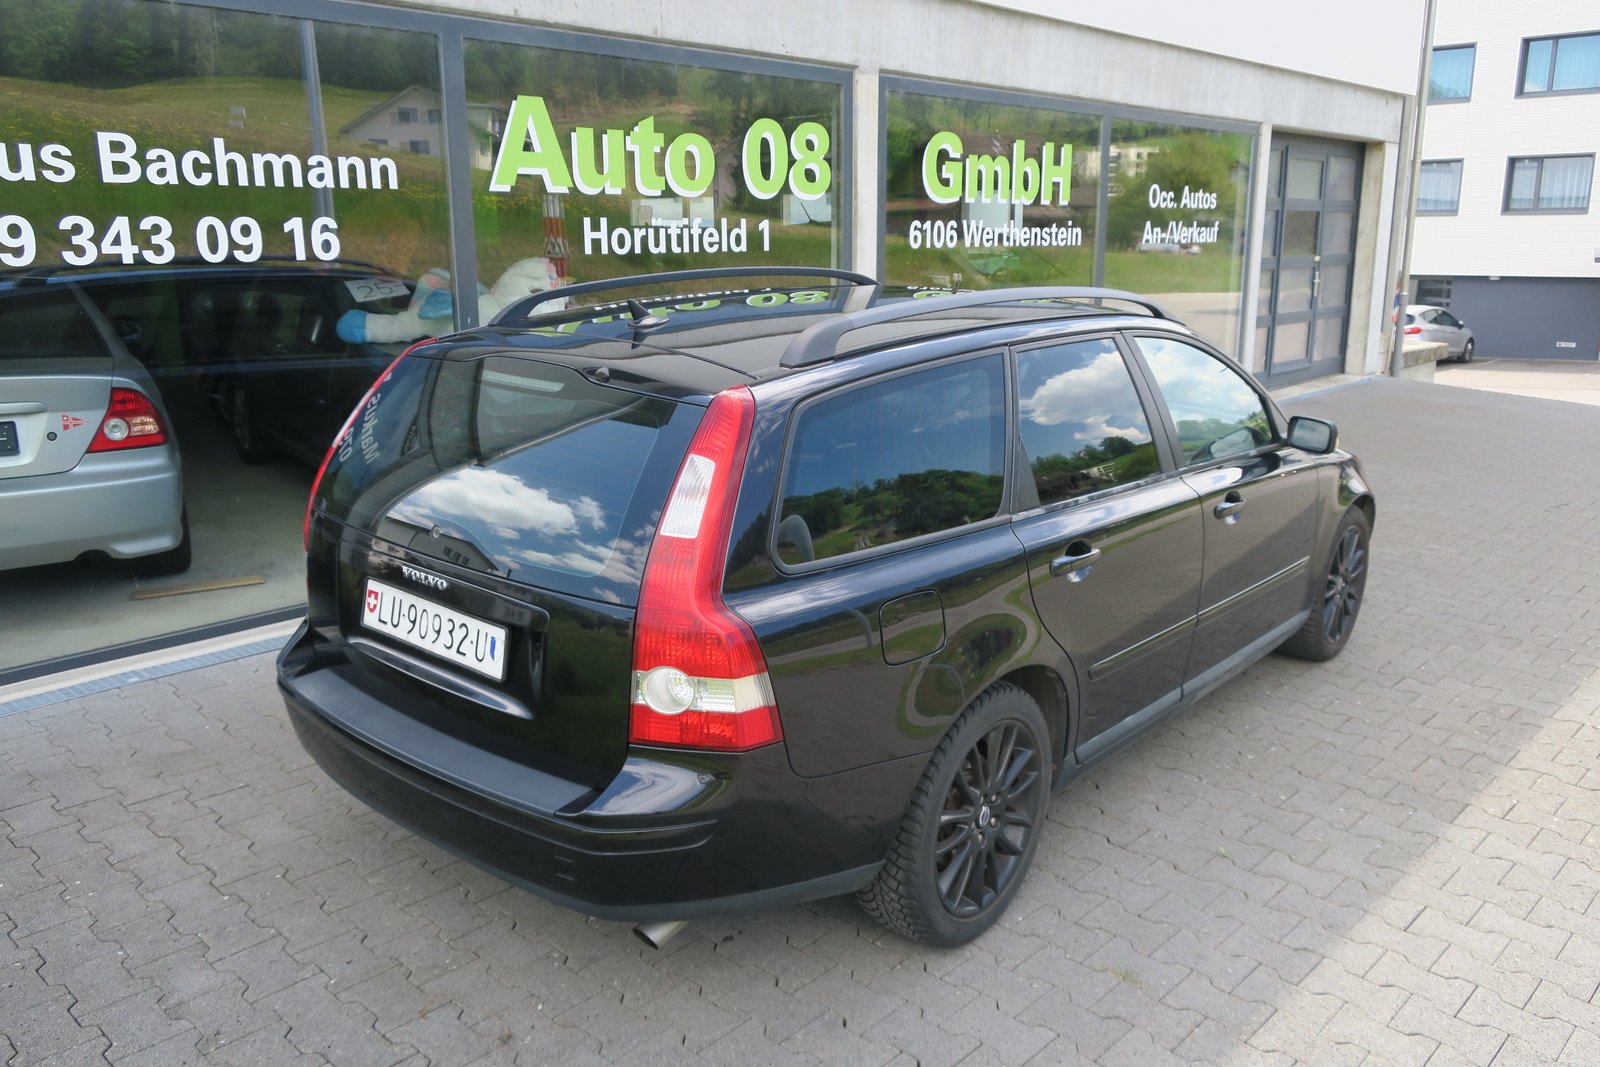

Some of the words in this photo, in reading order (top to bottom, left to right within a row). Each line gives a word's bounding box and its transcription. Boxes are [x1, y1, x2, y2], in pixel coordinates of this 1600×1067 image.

[96, 131, 399, 191] Bachmann
[490, 95, 715, 199] Auto
[743, 118, 832, 200] 08
[922, 131, 1073, 206] GmbH
[1149, 184, 1177, 209] Occ.
[1180, 185, 1217, 210] Autos
[58, 215, 176, 267] 343
[196, 216, 263, 262] 09
[283, 216, 341, 261] 16
[758, 219, 770, 251] 1
[909, 220, 957, 249] 6106
[962, 220, 1082, 248] Werthenstein
[1142, 220, 1220, 245] An-/Verkauf
[401, 565, 448, 591] VOLVO
